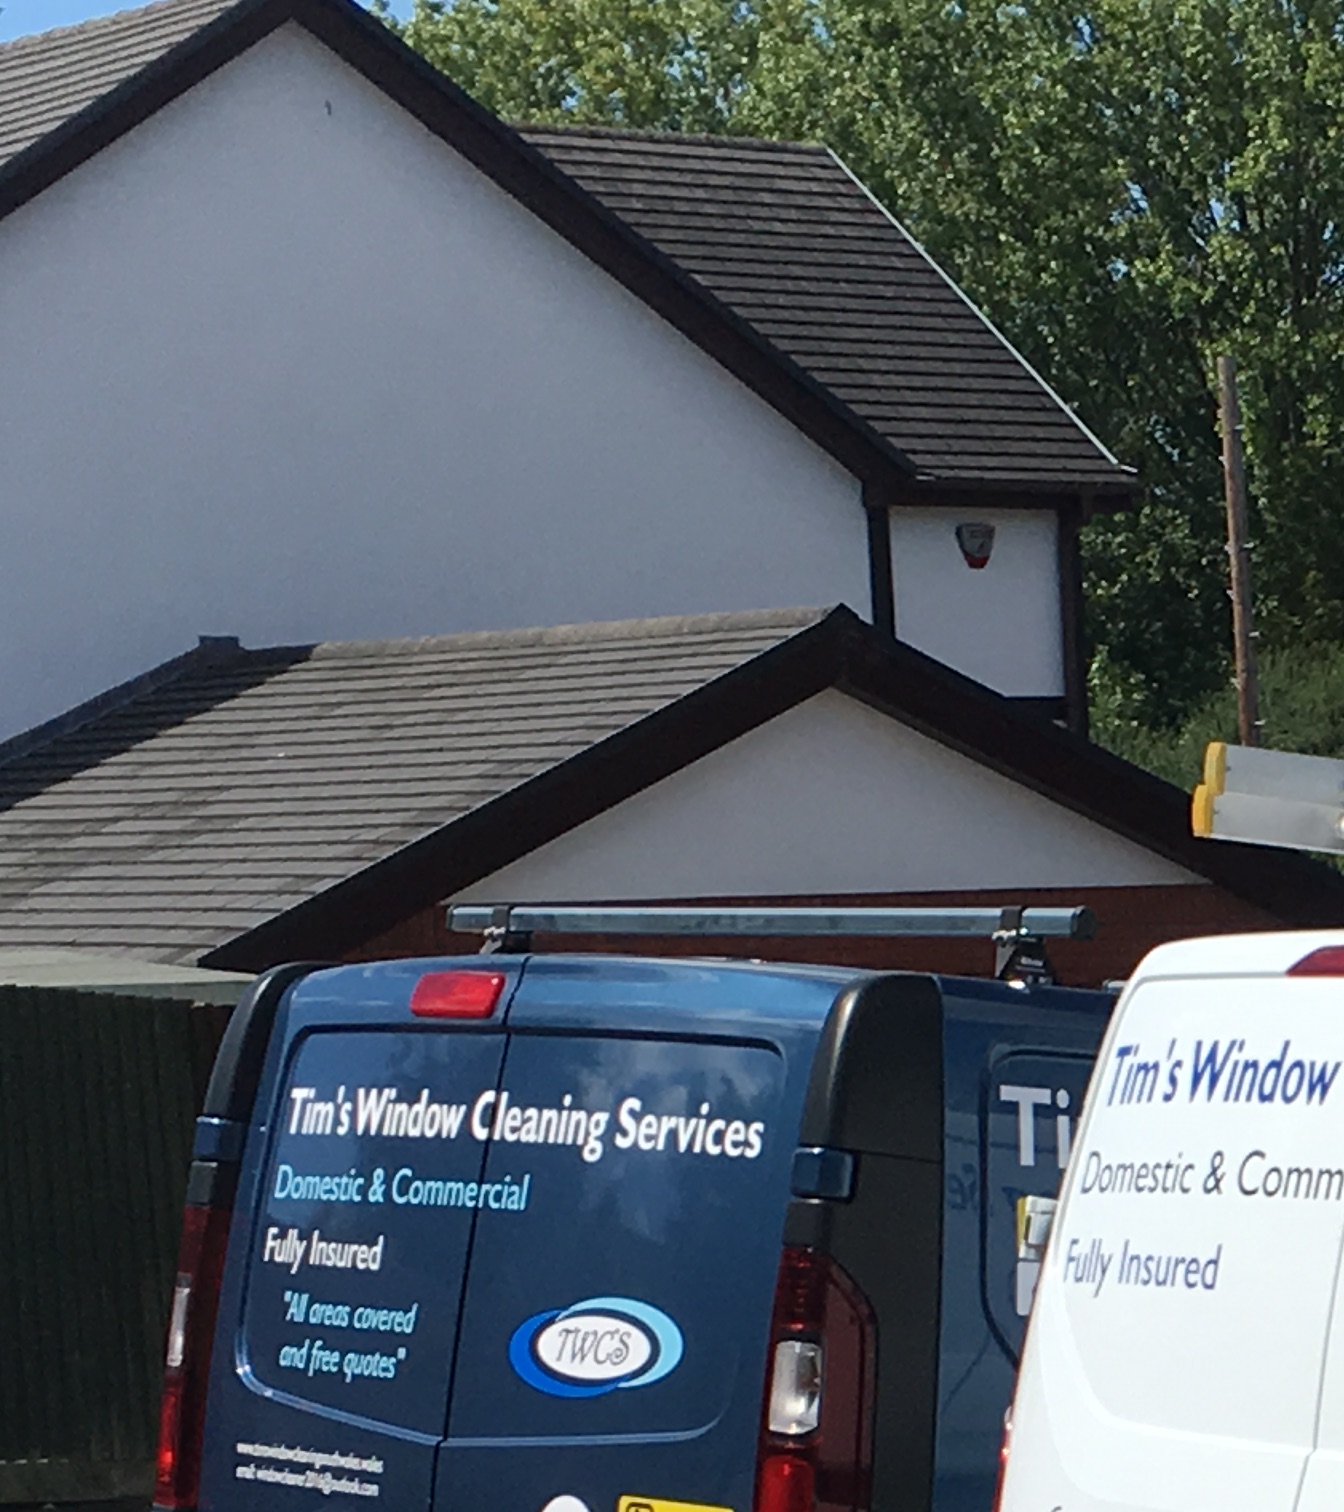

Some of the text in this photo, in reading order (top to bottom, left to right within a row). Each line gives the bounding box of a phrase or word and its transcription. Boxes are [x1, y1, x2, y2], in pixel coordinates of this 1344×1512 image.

[1107, 1038, 1184, 1107] Tim's
[1189, 1039, 1343, 1106] Window
[289, 1085, 764, 1163] Tim's Window Cleaning Services
[274, 1164, 531, 1210] Domestic & Commercial
[1081, 1150, 1195, 1195] Domestic
[1203, 1150, 1226, 1195] &
[263, 1227, 384, 1274] Fully Insured
[1063, 1238, 1223, 1298] Fully Insured
[283, 1290, 419, 1333] "All areas covered
[278, 1339, 406, 1383] and free quotes"
[555, 1326, 633, 1367] TWCS
